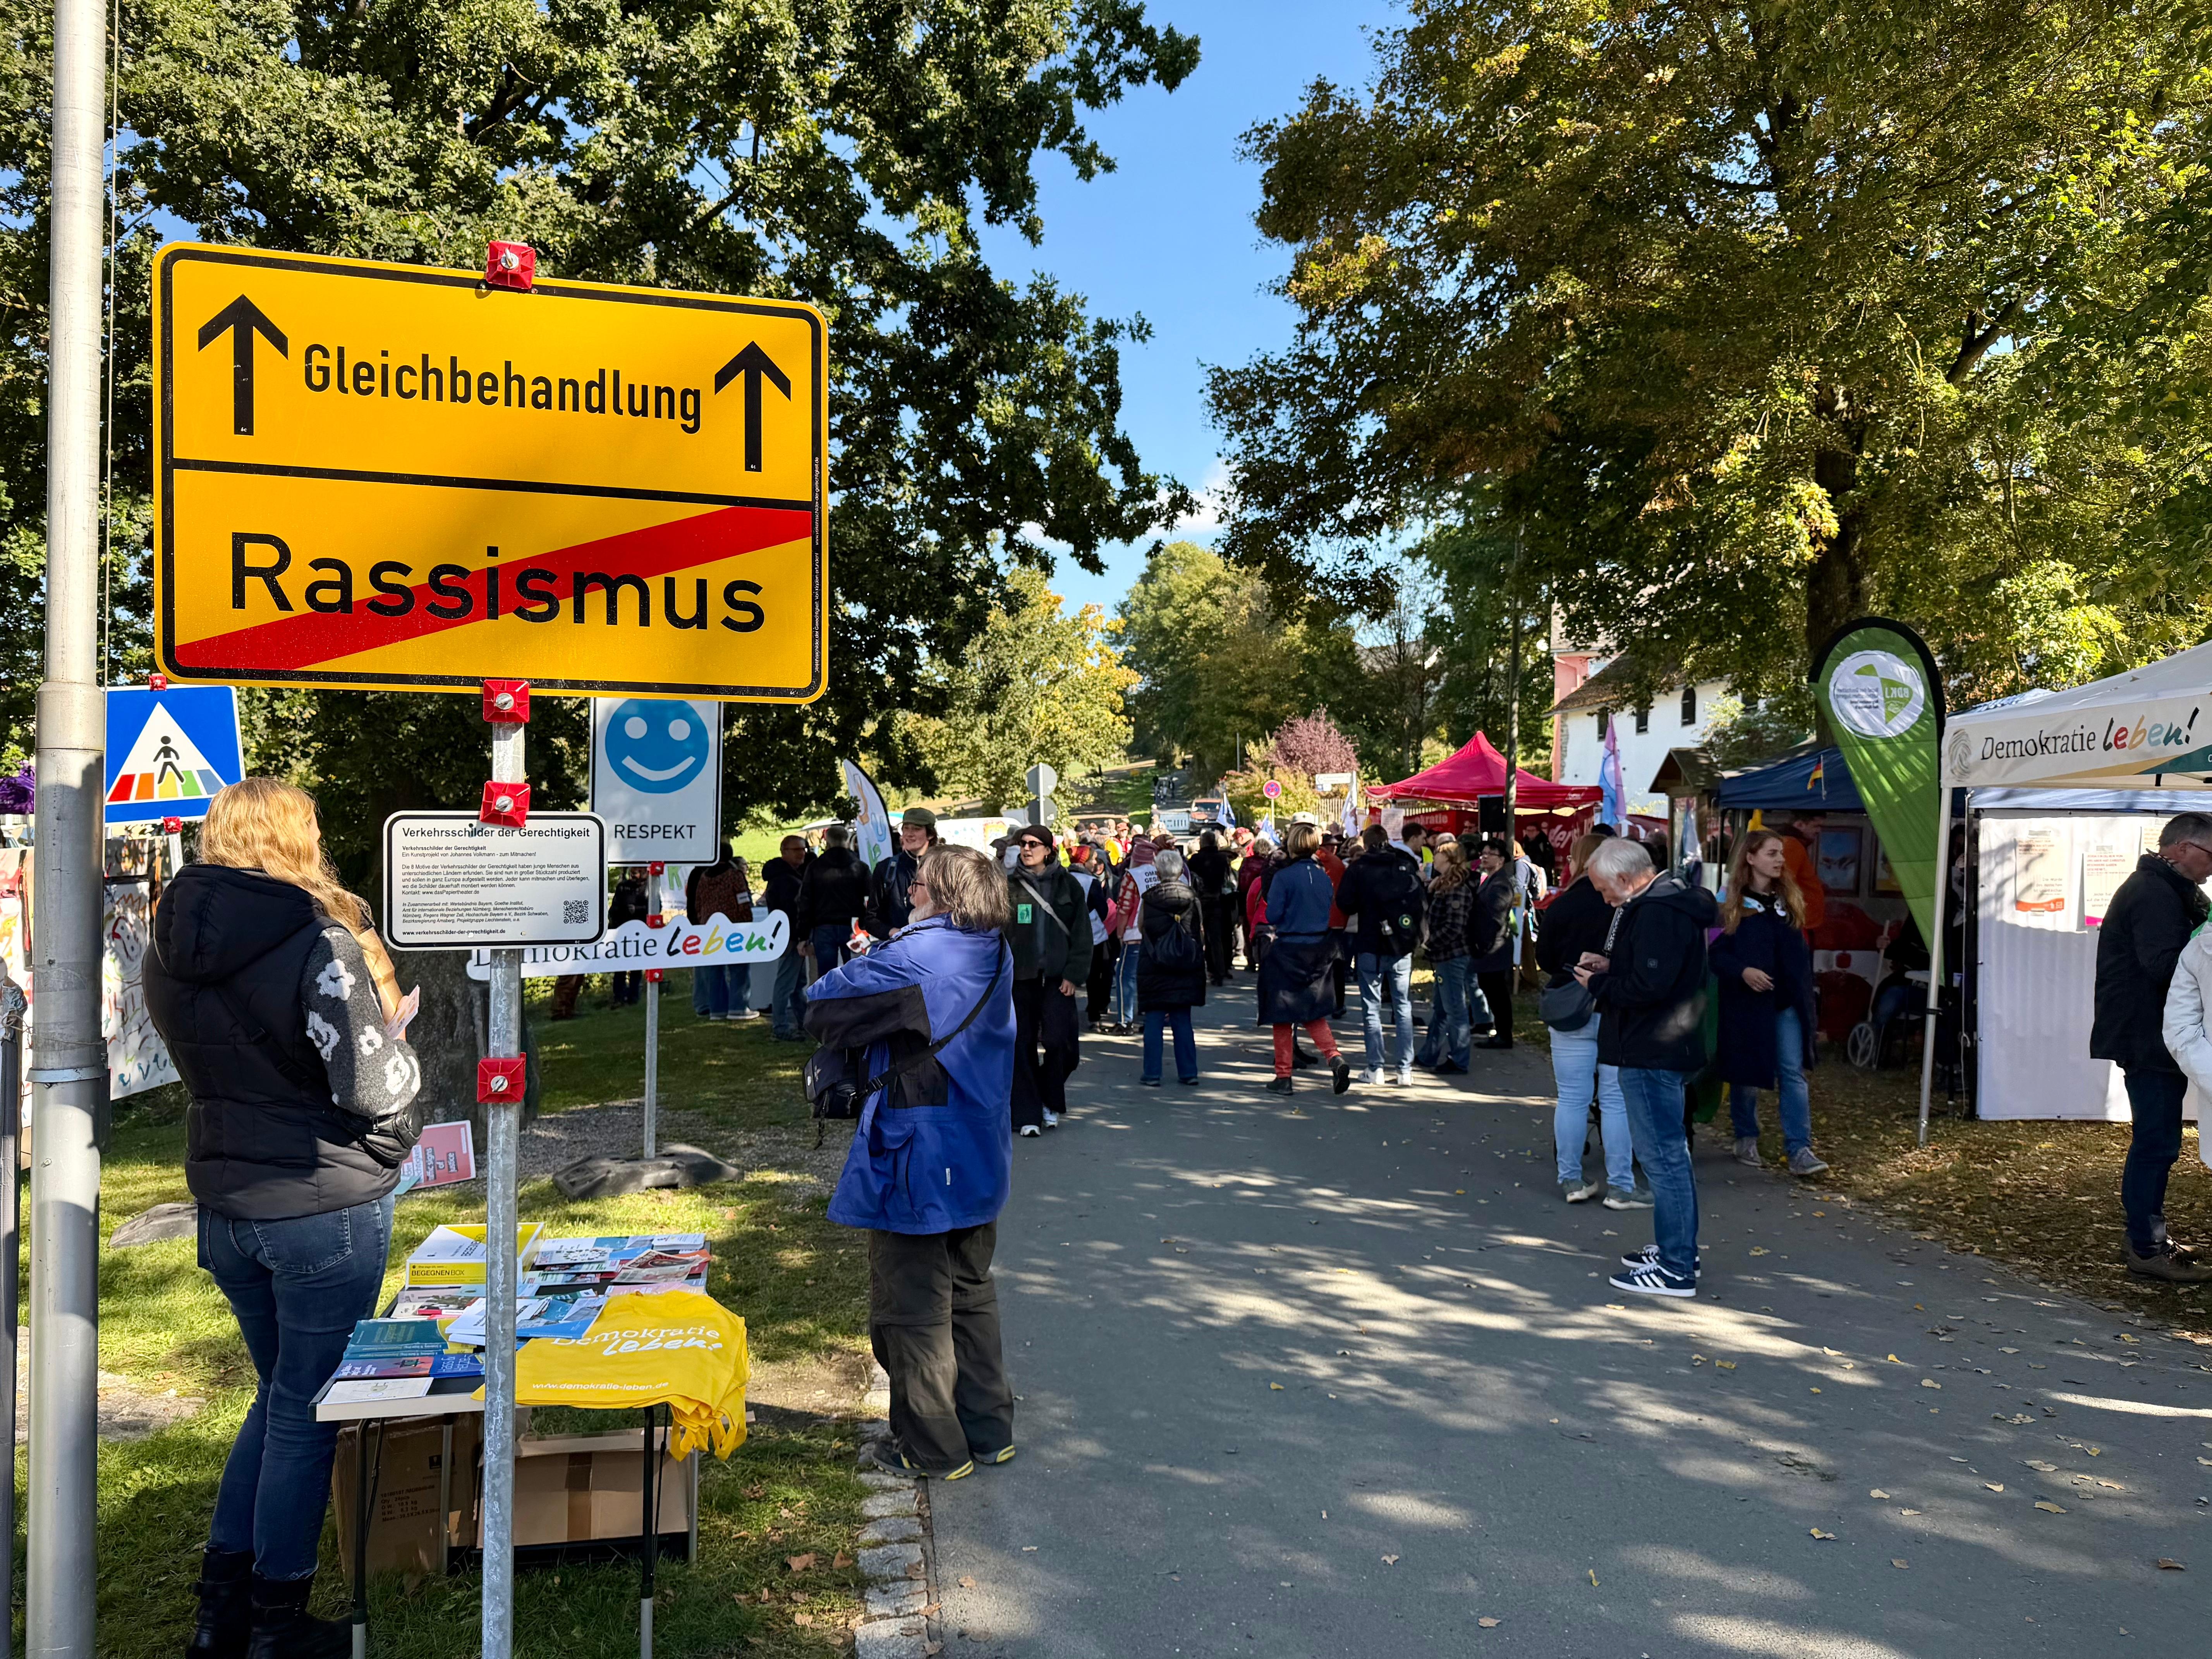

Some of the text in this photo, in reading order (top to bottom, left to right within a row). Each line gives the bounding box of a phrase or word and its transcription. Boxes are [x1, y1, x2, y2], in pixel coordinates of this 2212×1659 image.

[304, 343, 701, 434] Gleichbehandlung
[231, 531, 766, 634] Rassismus
[1980, 725, 2095, 761] Demokratie
[402, 828, 590, 839] Verkehrsschilder der Gerechtigkeit
[614, 824, 696, 839] RESPEKT
[532, 1381, 669, 1391] www.demokratie-leben.de
